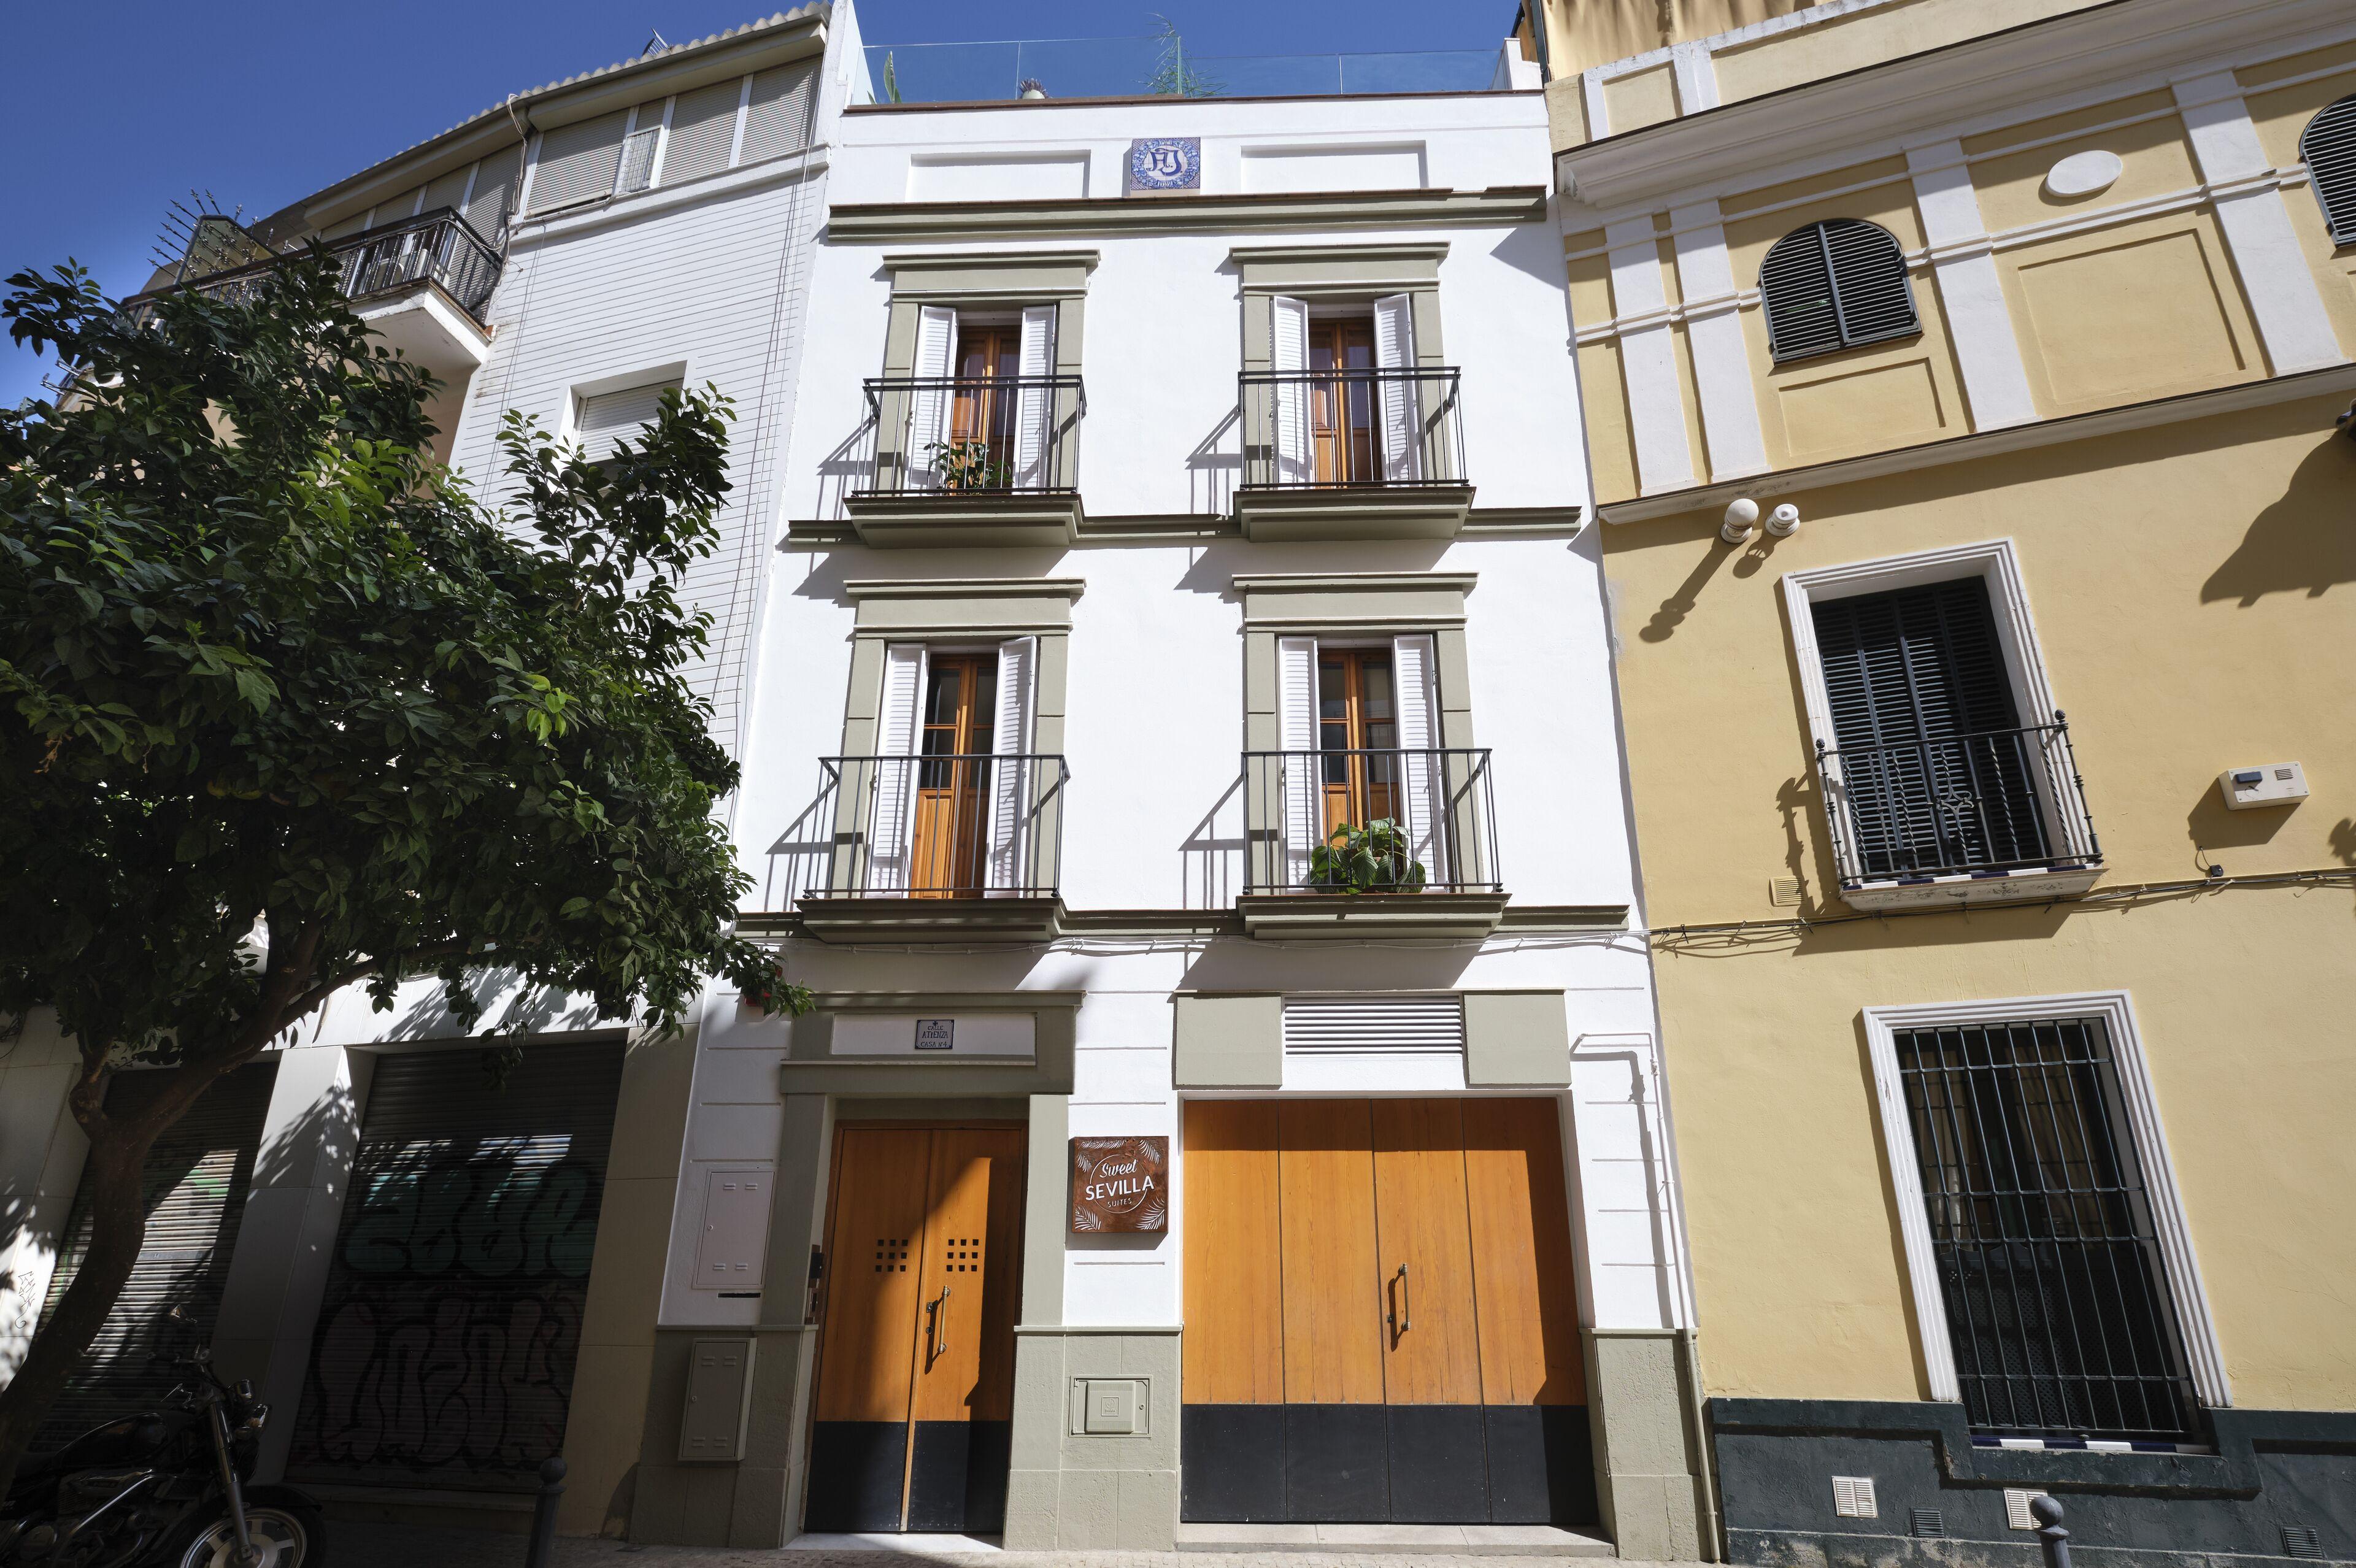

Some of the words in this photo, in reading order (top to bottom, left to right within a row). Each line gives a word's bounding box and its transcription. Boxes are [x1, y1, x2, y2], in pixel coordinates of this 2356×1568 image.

[1099, 1159, 1138, 1178] Sweet
[1085, 1175, 1155, 1201] SEVILLA
[1107, 1197, 1133, 1208] SUITES
